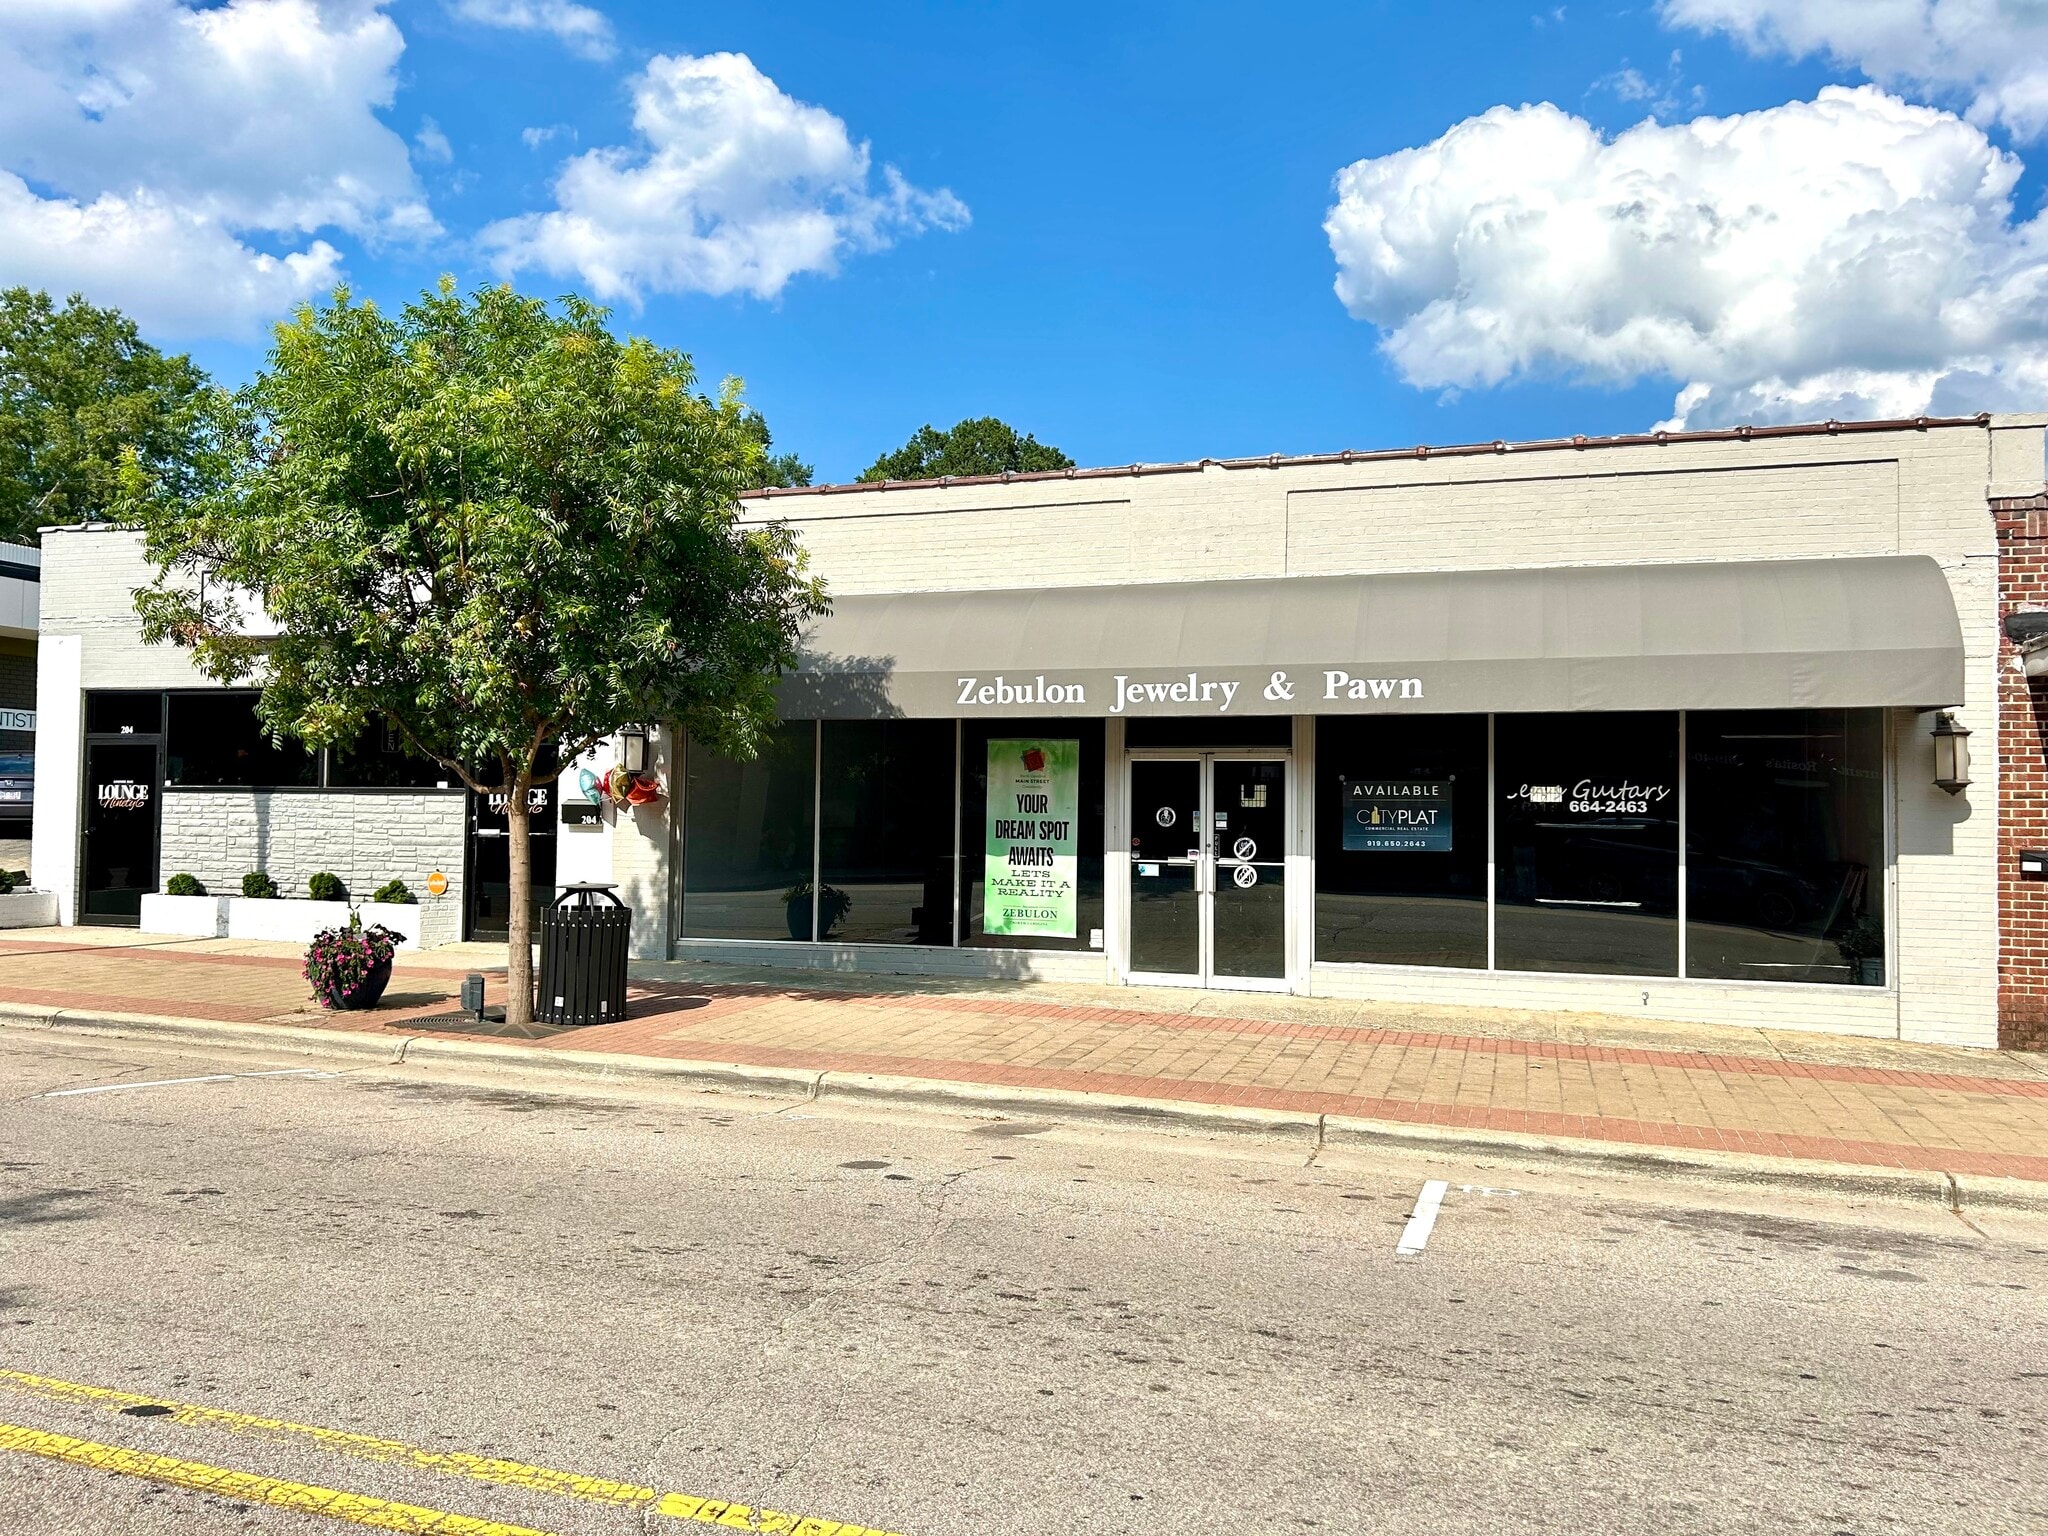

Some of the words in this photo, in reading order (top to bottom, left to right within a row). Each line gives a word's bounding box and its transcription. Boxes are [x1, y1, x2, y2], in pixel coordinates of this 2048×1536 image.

[957, 675, 1086, 704] Zebulon
[1109, 673, 1240, 713] Jewelry
[1263, 671, 1295, 701] &
[1323, 670, 1424, 699] Pawn
[0, 711, 36, 728] TIST
[120, 725, 134, 734] 204
[98, 784, 149, 799] LOUNGE
[1353, 785, 1439, 796] AVAILABLE
[1572, 779, 1670, 801] Guitars
[488, 789, 548, 805] LOGE
[1016, 794, 1048, 813] YOUR
[1569, 801, 1647, 812] 664-2463
[581, 815, 597, 824] 204
[995, 820, 1035, 839] DREAM
[1039, 821, 1070, 840] SPOT
[1008, 846, 1054, 866] AWAITS
[1011, 870, 1050, 878] LETS
[991, 878, 1036, 887] MAKE
[998, 888, 1064, 897] REALITY
[1003, 908, 1058, 919] ZEBULON
